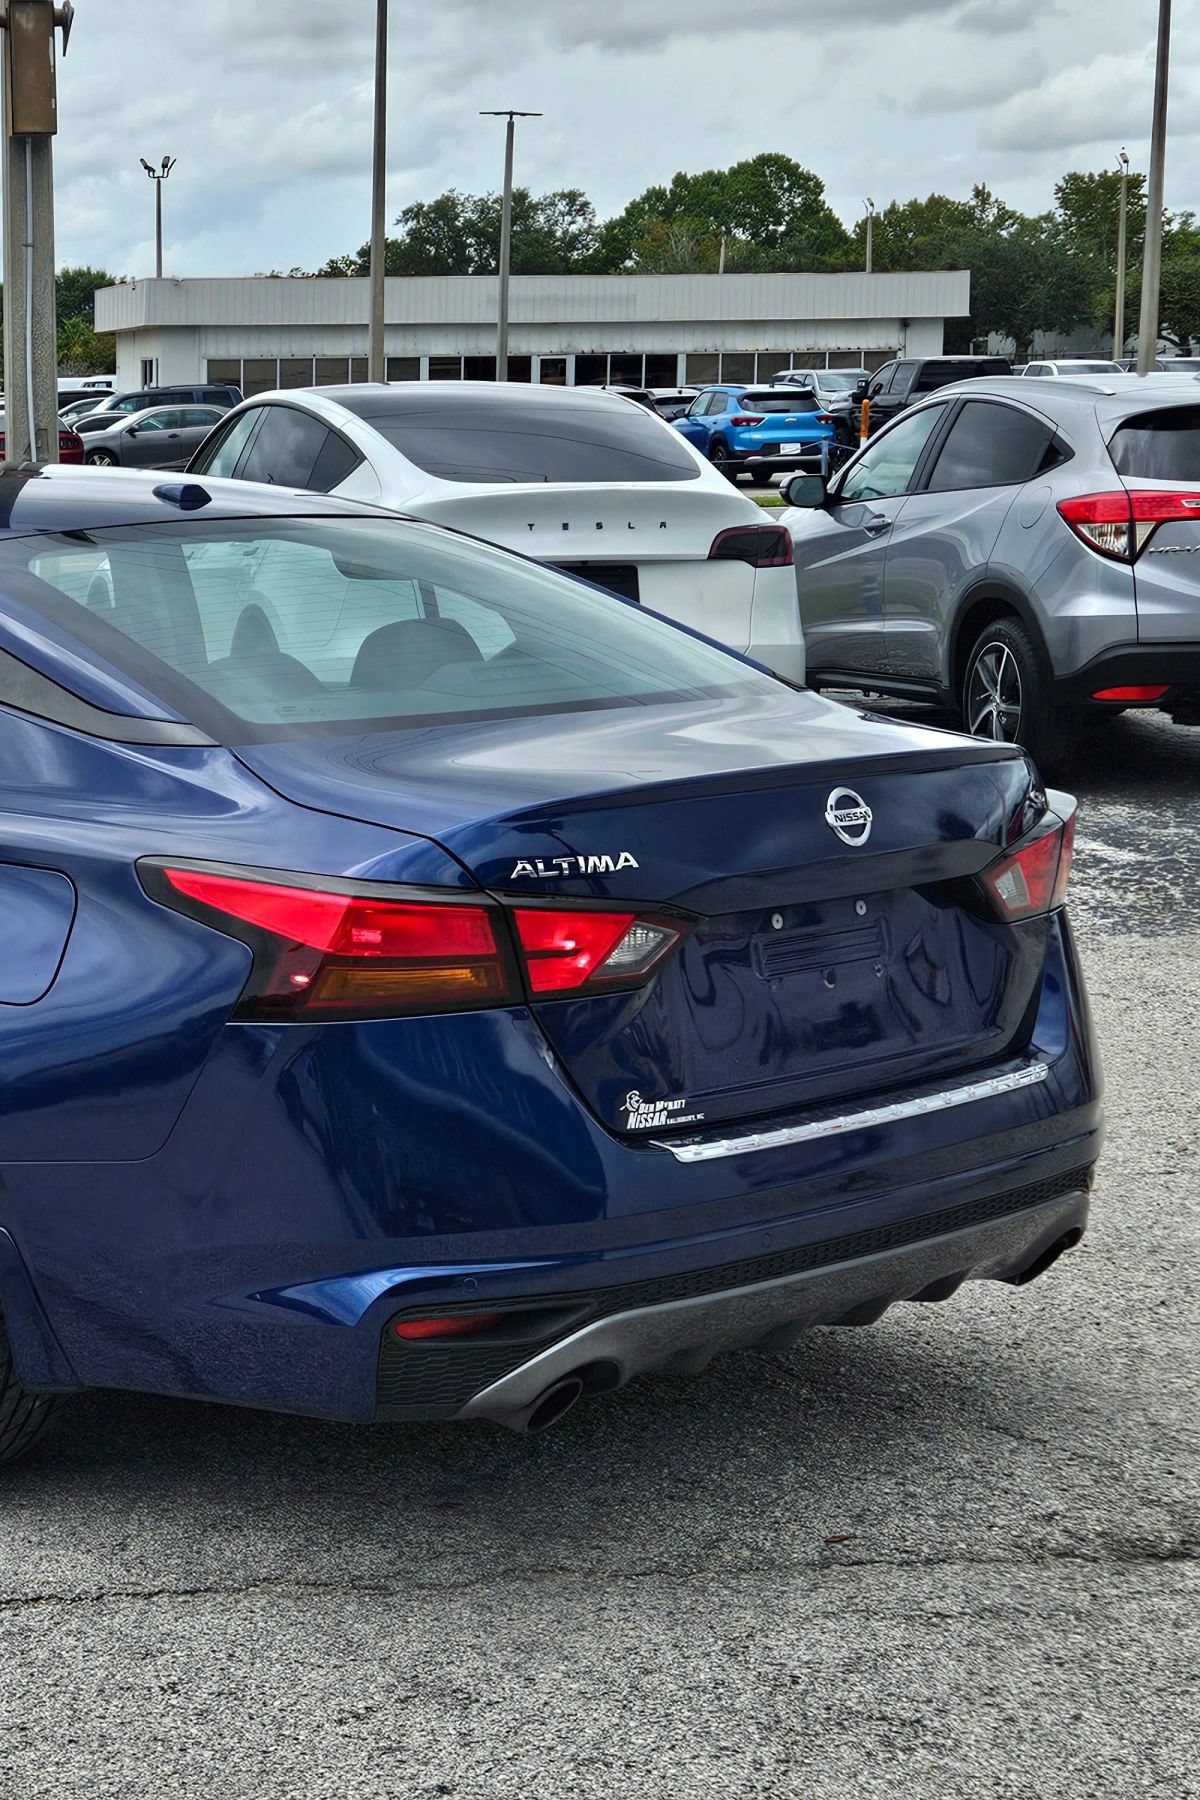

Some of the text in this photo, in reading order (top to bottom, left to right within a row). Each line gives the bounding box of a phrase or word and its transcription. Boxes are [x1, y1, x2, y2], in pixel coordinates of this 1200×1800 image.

[527, 521, 667, 531] TESLA
[834, 810, 871, 823] NISSAN
[510, 852, 640, 879] ALTIMA
[626, 1110, 668, 1130] NISSAN
